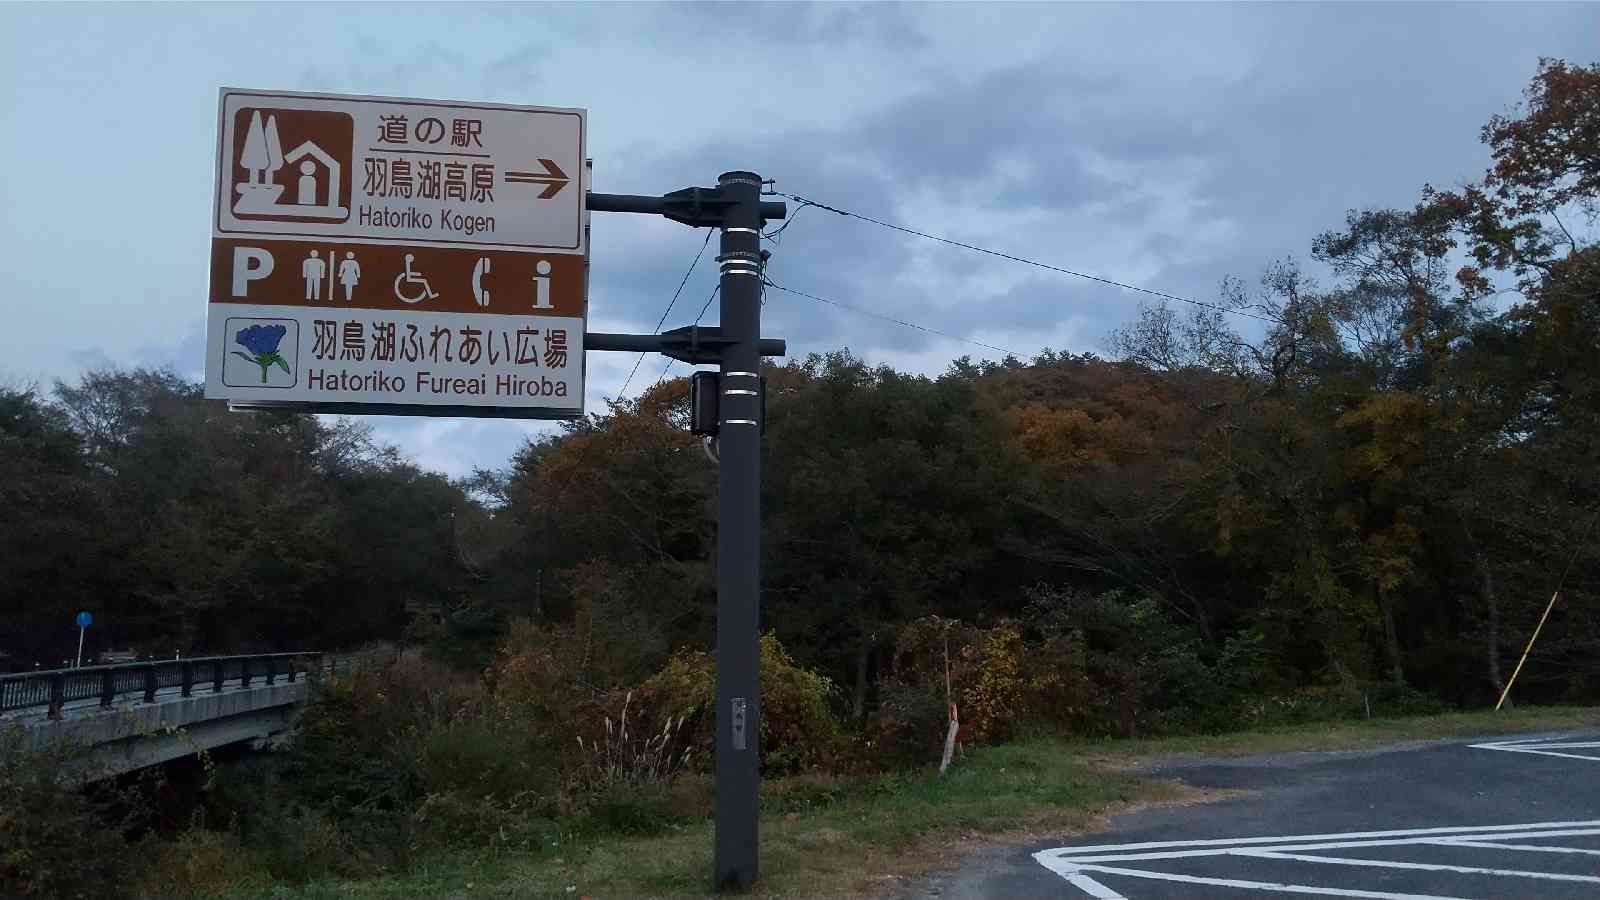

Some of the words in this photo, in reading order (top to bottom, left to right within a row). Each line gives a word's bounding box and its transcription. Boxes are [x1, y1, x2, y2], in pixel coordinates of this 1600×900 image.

[376, 113, 483, 148] 道の駅
[363, 157, 495, 203] 羽鳥湖高原
[359, 205, 432, 229] Hatoriko
[440, 209, 495, 236] Kogen
[231, 246, 274, 297] P
[311, 319, 568, 369] 羽鳥湖ふれあい広場
[308, 369, 406, 393] Hatoriko
[416, 371, 486, 395] Fureai
[495, 373, 567, 397] Hiroba
